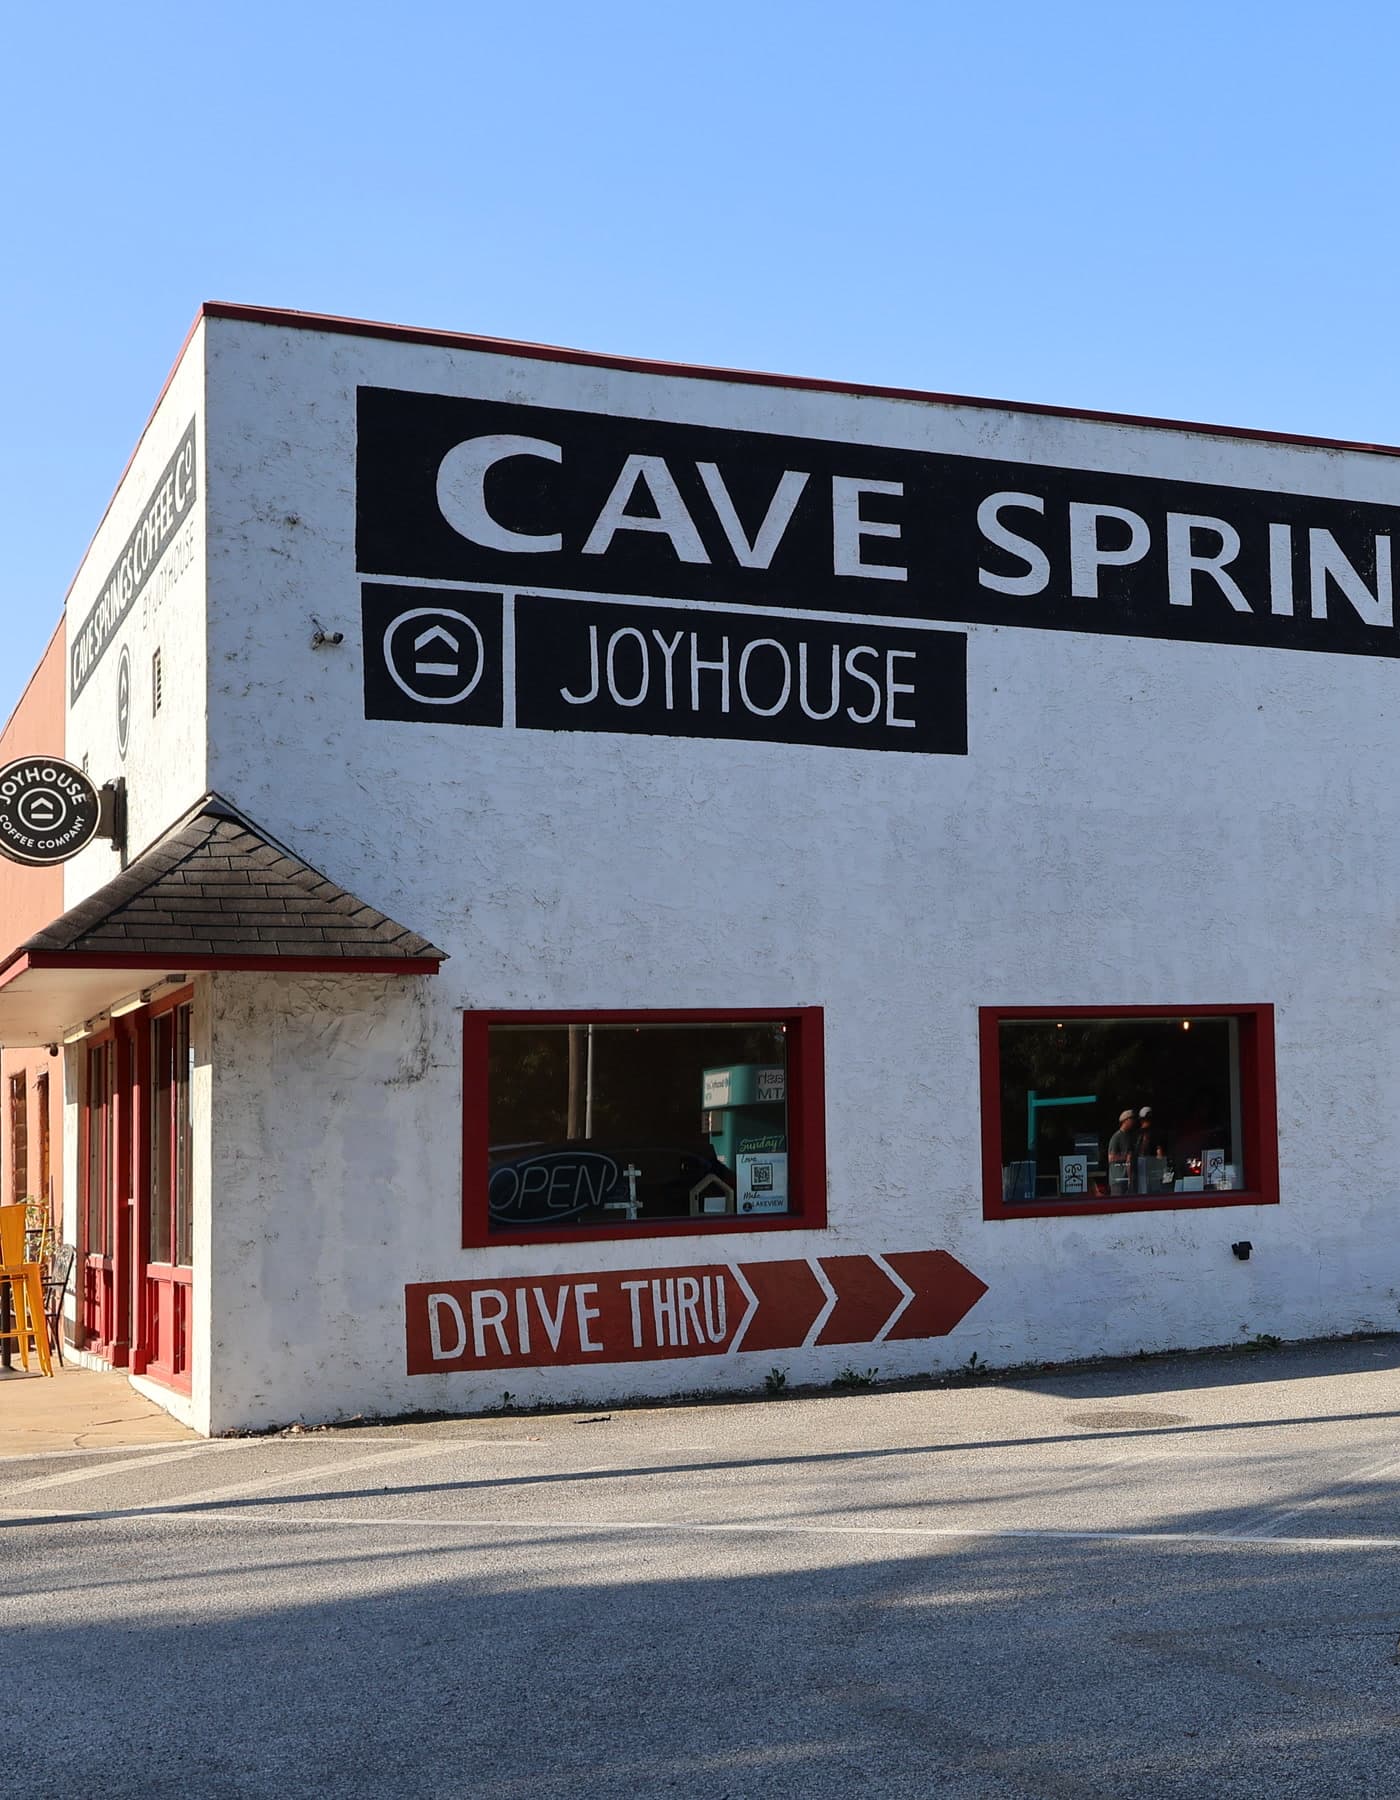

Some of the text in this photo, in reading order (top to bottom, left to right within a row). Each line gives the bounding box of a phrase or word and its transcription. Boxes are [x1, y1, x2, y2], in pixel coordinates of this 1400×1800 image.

[436, 434, 908, 582] CAVE
[73, 619, 94, 691] CAVE
[94, 547, 133, 656] SPRINGS
[133, 472, 174, 585] COFFEE
[153, 519, 194, 613] JOYHOUSE
[560, 624, 916, 728] JOYHOUSE
[0, 767, 87, 805] JOYHOUSE
[0, 814, 85, 849] COFFEE COMPANY
[488, 1164, 607, 1211] OPEN
[427, 1275, 727, 1361] DRIVE THRU
